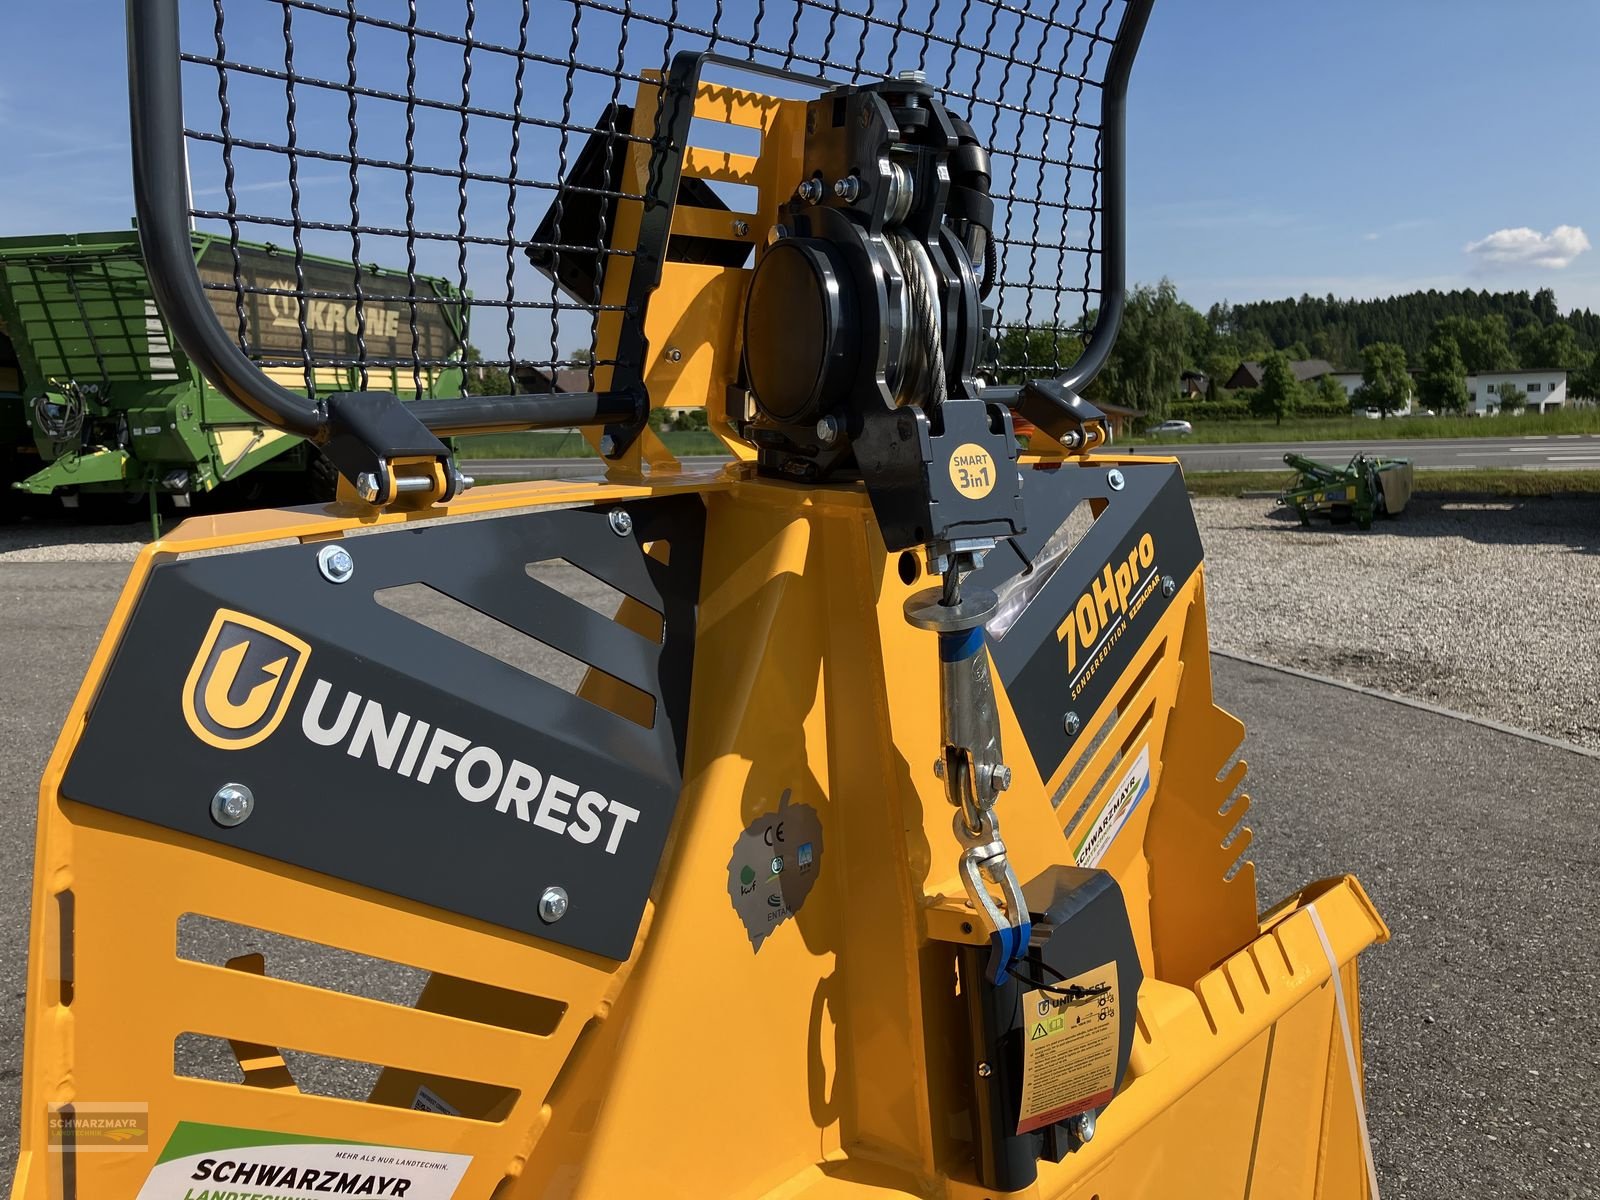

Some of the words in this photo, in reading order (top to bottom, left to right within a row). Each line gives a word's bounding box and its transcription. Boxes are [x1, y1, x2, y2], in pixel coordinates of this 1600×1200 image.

[306, 300, 399, 337] KRONE
[954, 455, 987, 466] SMART
[959, 467, 989, 488] 3in1
[1056, 533, 1154, 674] 70Hpro
[1071, 620, 1127, 701] SONDEREDITION
[302, 678, 640, 855] UNIFOREST
[767, 904, 792, 922] ENTAM
[191, 1159, 411, 1197] SCHWARZMAYR
[335, 1151, 359, 1160] MEHR
[360, 1154, 376, 1162] ALS
[377, 1156, 395, 1164] NUR
[395, 1159, 449, 1171] LANDTECHNIK.
